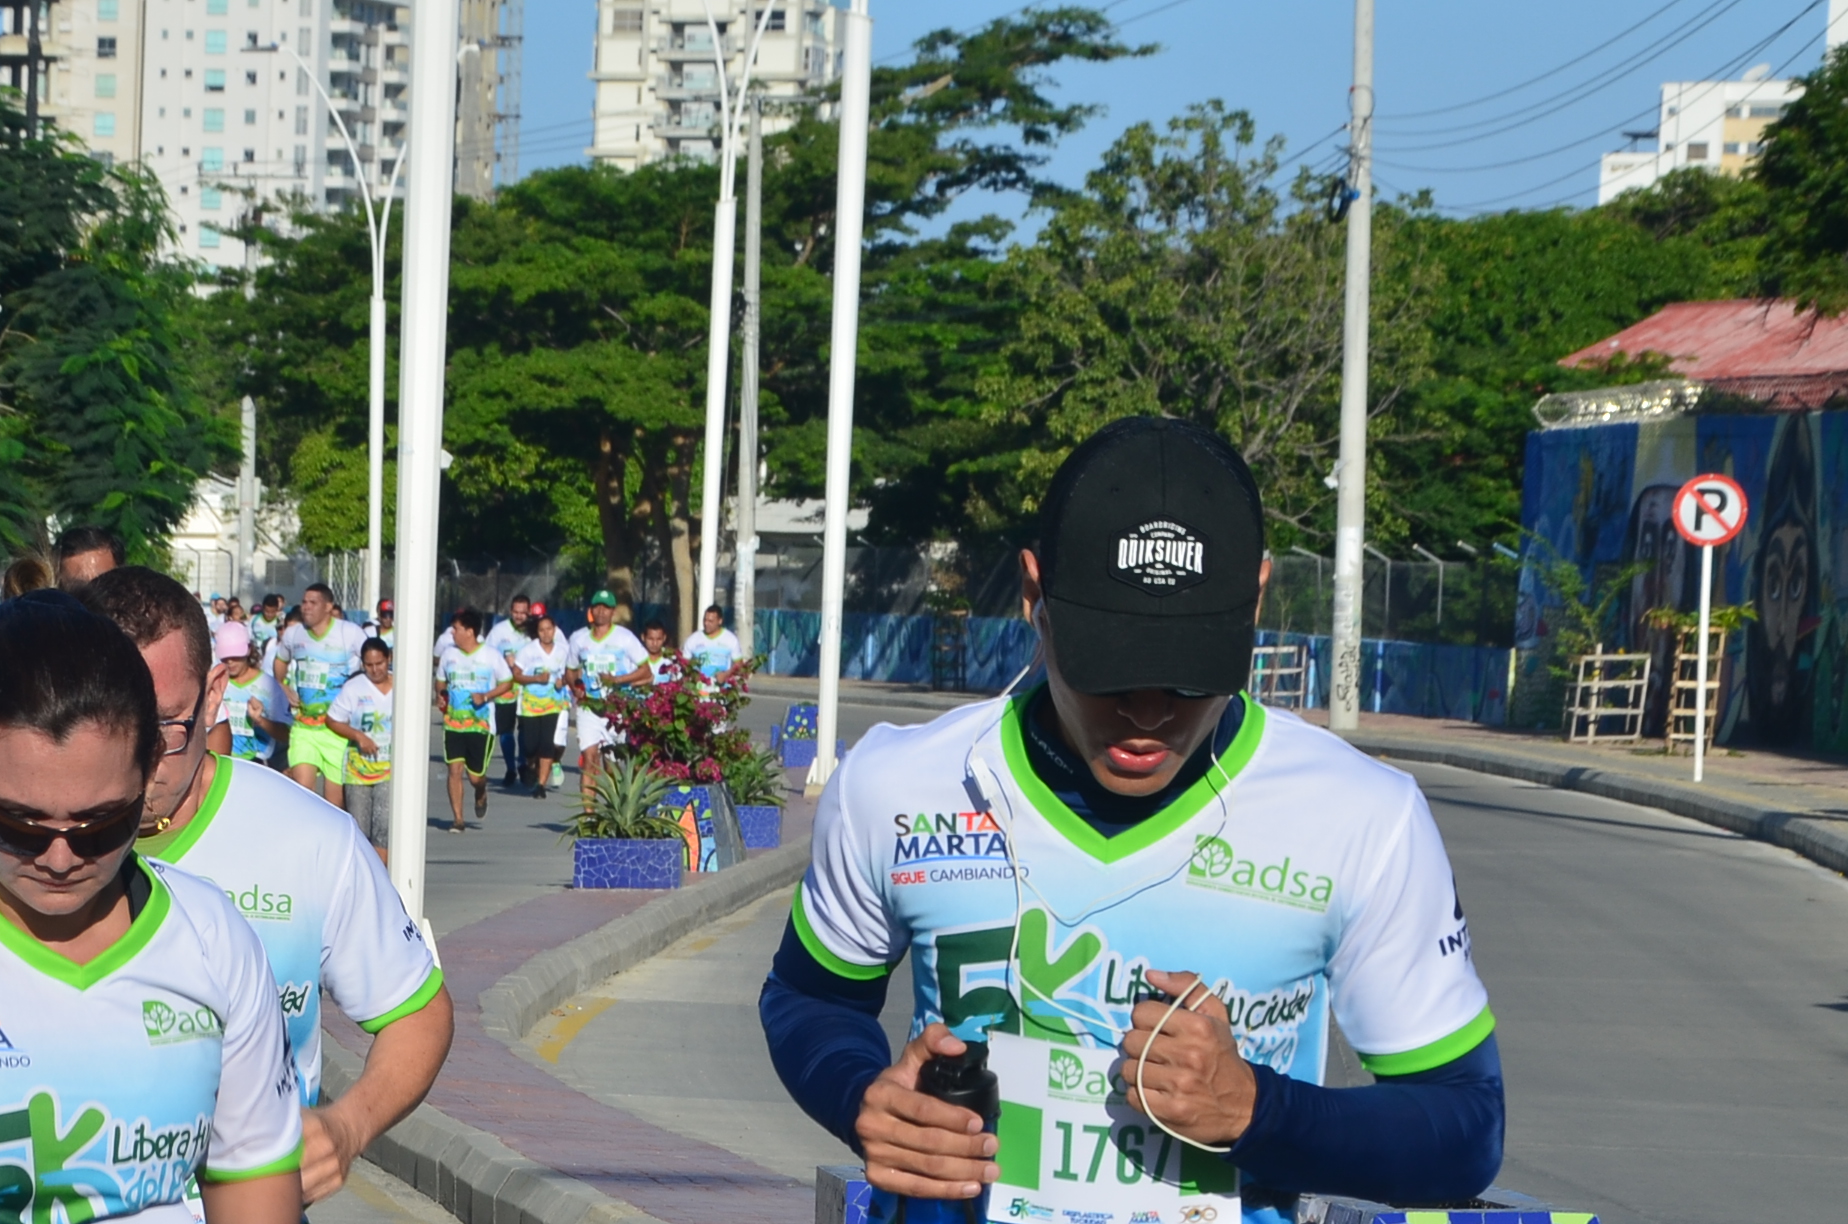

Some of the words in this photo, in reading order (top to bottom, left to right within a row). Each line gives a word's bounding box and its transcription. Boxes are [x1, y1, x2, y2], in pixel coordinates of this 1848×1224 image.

[1694, 489, 1728, 532] P
[1117, 538, 1203, 574] QUIKSILVER
[894, 811, 1002, 838] SANTA
[893, 832, 1007, 865] MARTA
[890, 869, 926, 885] SIGUE
[929, 866, 1030, 883] CAMBIANDO
[935, 908, 1102, 1050] 5K
[112, 1122, 191, 1164] Libera
[1052, 1119, 1174, 1186] 1767
